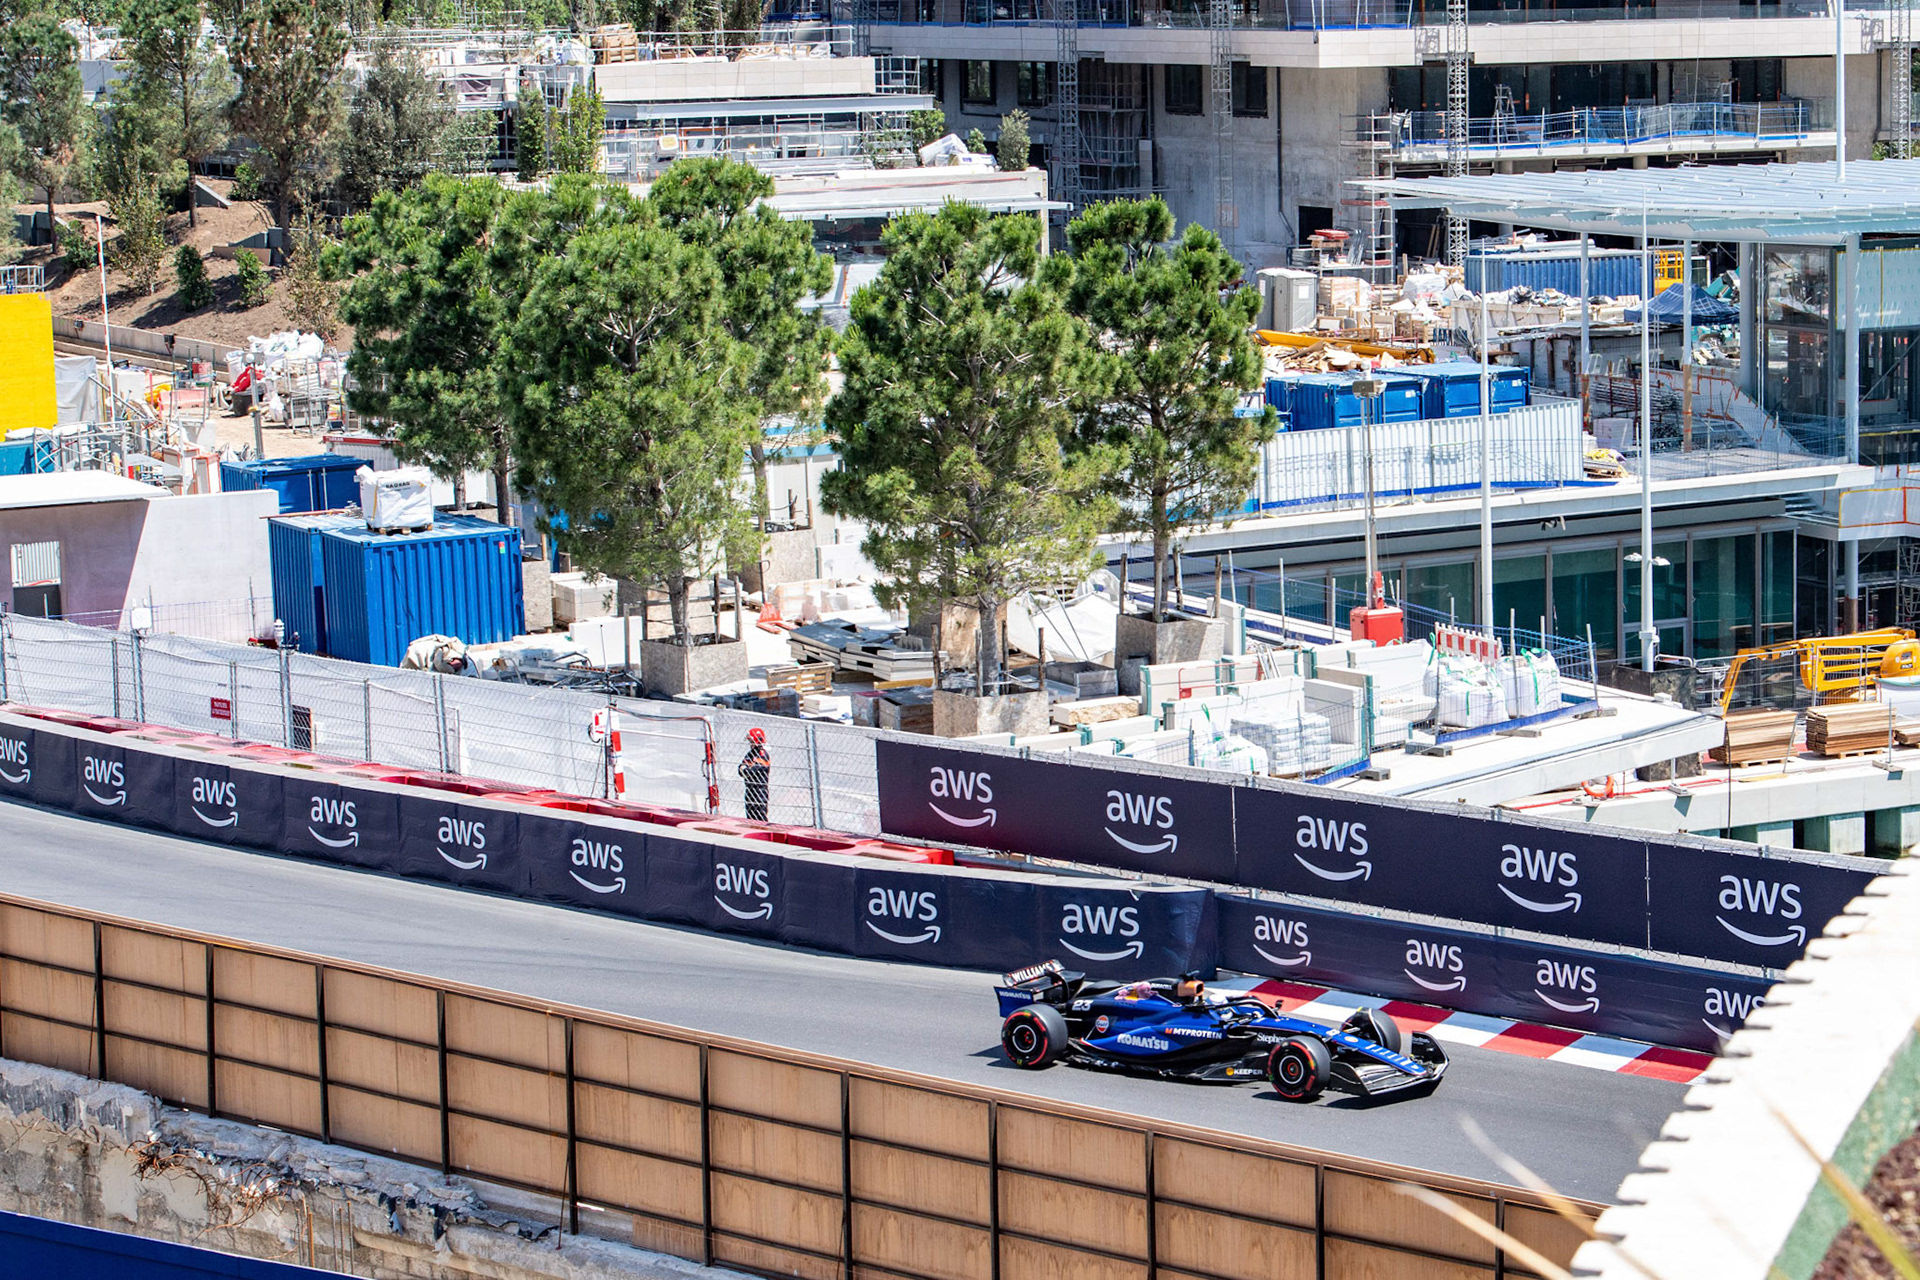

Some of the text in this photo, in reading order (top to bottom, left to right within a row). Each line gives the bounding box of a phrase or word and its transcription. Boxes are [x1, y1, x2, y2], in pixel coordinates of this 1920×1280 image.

[84, 755, 124, 787] aws
[930, 766, 994, 804] aws
[192, 776, 236, 808] aws
[311, 796, 356, 828] aws
[1106, 790, 1174, 829] aws
[439, 816, 486, 847] aws
[1296, 815, 1369, 856] aws
[571, 838, 624, 873] aws
[1500, 844, 1579, 888] aws
[716, 863, 770, 898] aws
[1719, 875, 1803, 920] aws
[868, 887, 938, 923] aws
[1063, 904, 1139, 939] aws
[1254, 915, 1309, 949] aws
[1406, 939, 1466, 973] aws
[1536, 959, 1597, 993] aws
[999, 990, 1031, 1000] KOMATSU
[1072, 1000, 1094, 1011] 23
[1117, 1033, 1169, 1051] KOMATSU
[1173, 1028, 1223, 1039] MYPROTEIN
[1233, 1067, 1263, 1076] KEEPER
